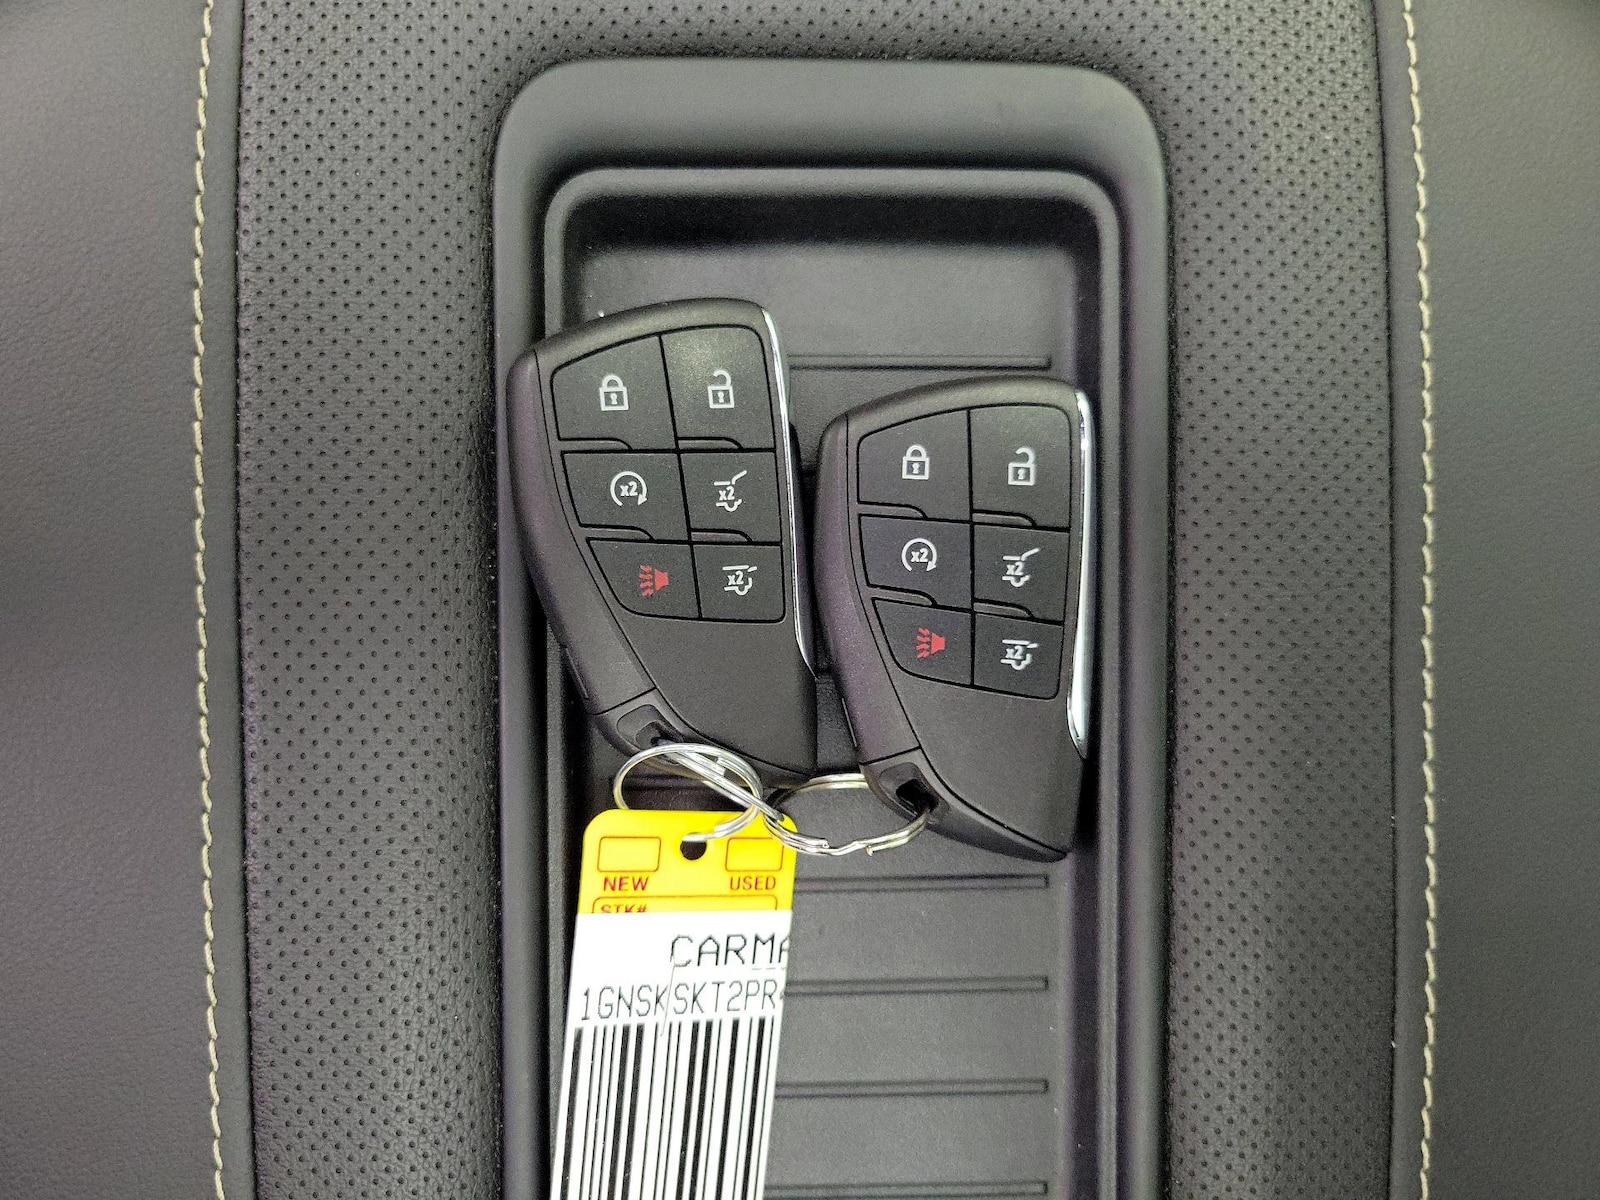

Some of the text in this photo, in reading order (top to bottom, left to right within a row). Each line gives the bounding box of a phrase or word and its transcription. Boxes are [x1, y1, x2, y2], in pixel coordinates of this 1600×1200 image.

[620, 481, 639, 496] x2
[718, 486, 735, 501] x2
[910, 548, 928, 563] x2
[1006, 561, 1024, 576] x2
[728, 570, 744, 585] x2
[1006, 645, 1024, 660] x2
[603, 876, 649, 892] NEW
[729, 876, 777, 891] USED
[581, 979, 778, 1021] 1GNSKSKT2PR
